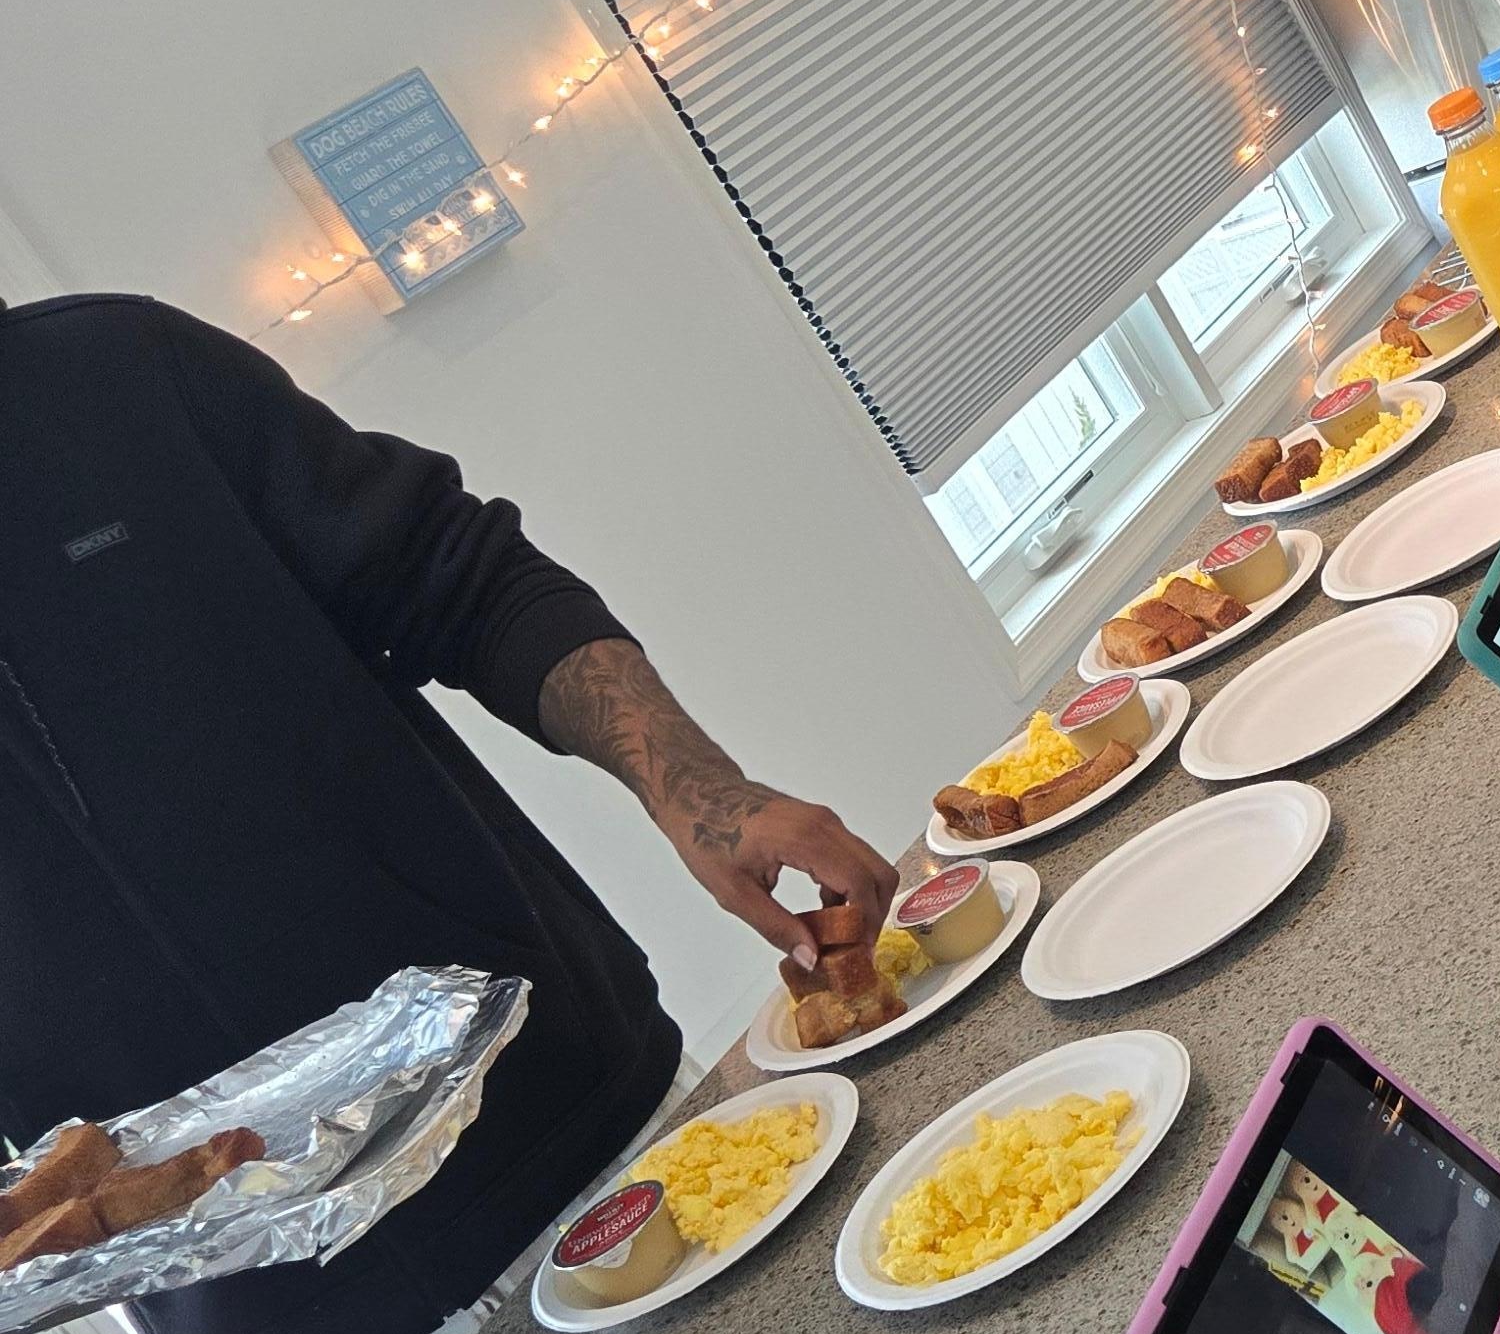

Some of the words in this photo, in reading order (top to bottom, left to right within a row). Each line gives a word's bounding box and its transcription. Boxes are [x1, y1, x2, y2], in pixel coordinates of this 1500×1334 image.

[309, 128, 346, 159] DOG
[341, 103, 389, 142] BEACH
[385, 81, 428, 117] RULES
[333, 146, 371, 176] FETCH
[369, 134, 392, 155] THE
[390, 109, 435, 143] FRISBEE
[350, 162, 388, 191] GUARD
[386, 150, 410, 171] THE
[407, 130, 443, 158] TOWEL
[367, 187, 389, 207] DIG
[387, 180, 401, 195] IN
[400, 167, 423, 187] THE
[421, 151, 451, 176] SAND
[388, 196, 417, 219] SWIM
[416, 187, 433, 202] ALL
[432, 174, 454, 193] DAY
[71, 525, 122, 556] DKNY
[567, 1193, 651, 1247] UNSWEETENED
[573, 1202, 648, 1255] APPLESAUCE
